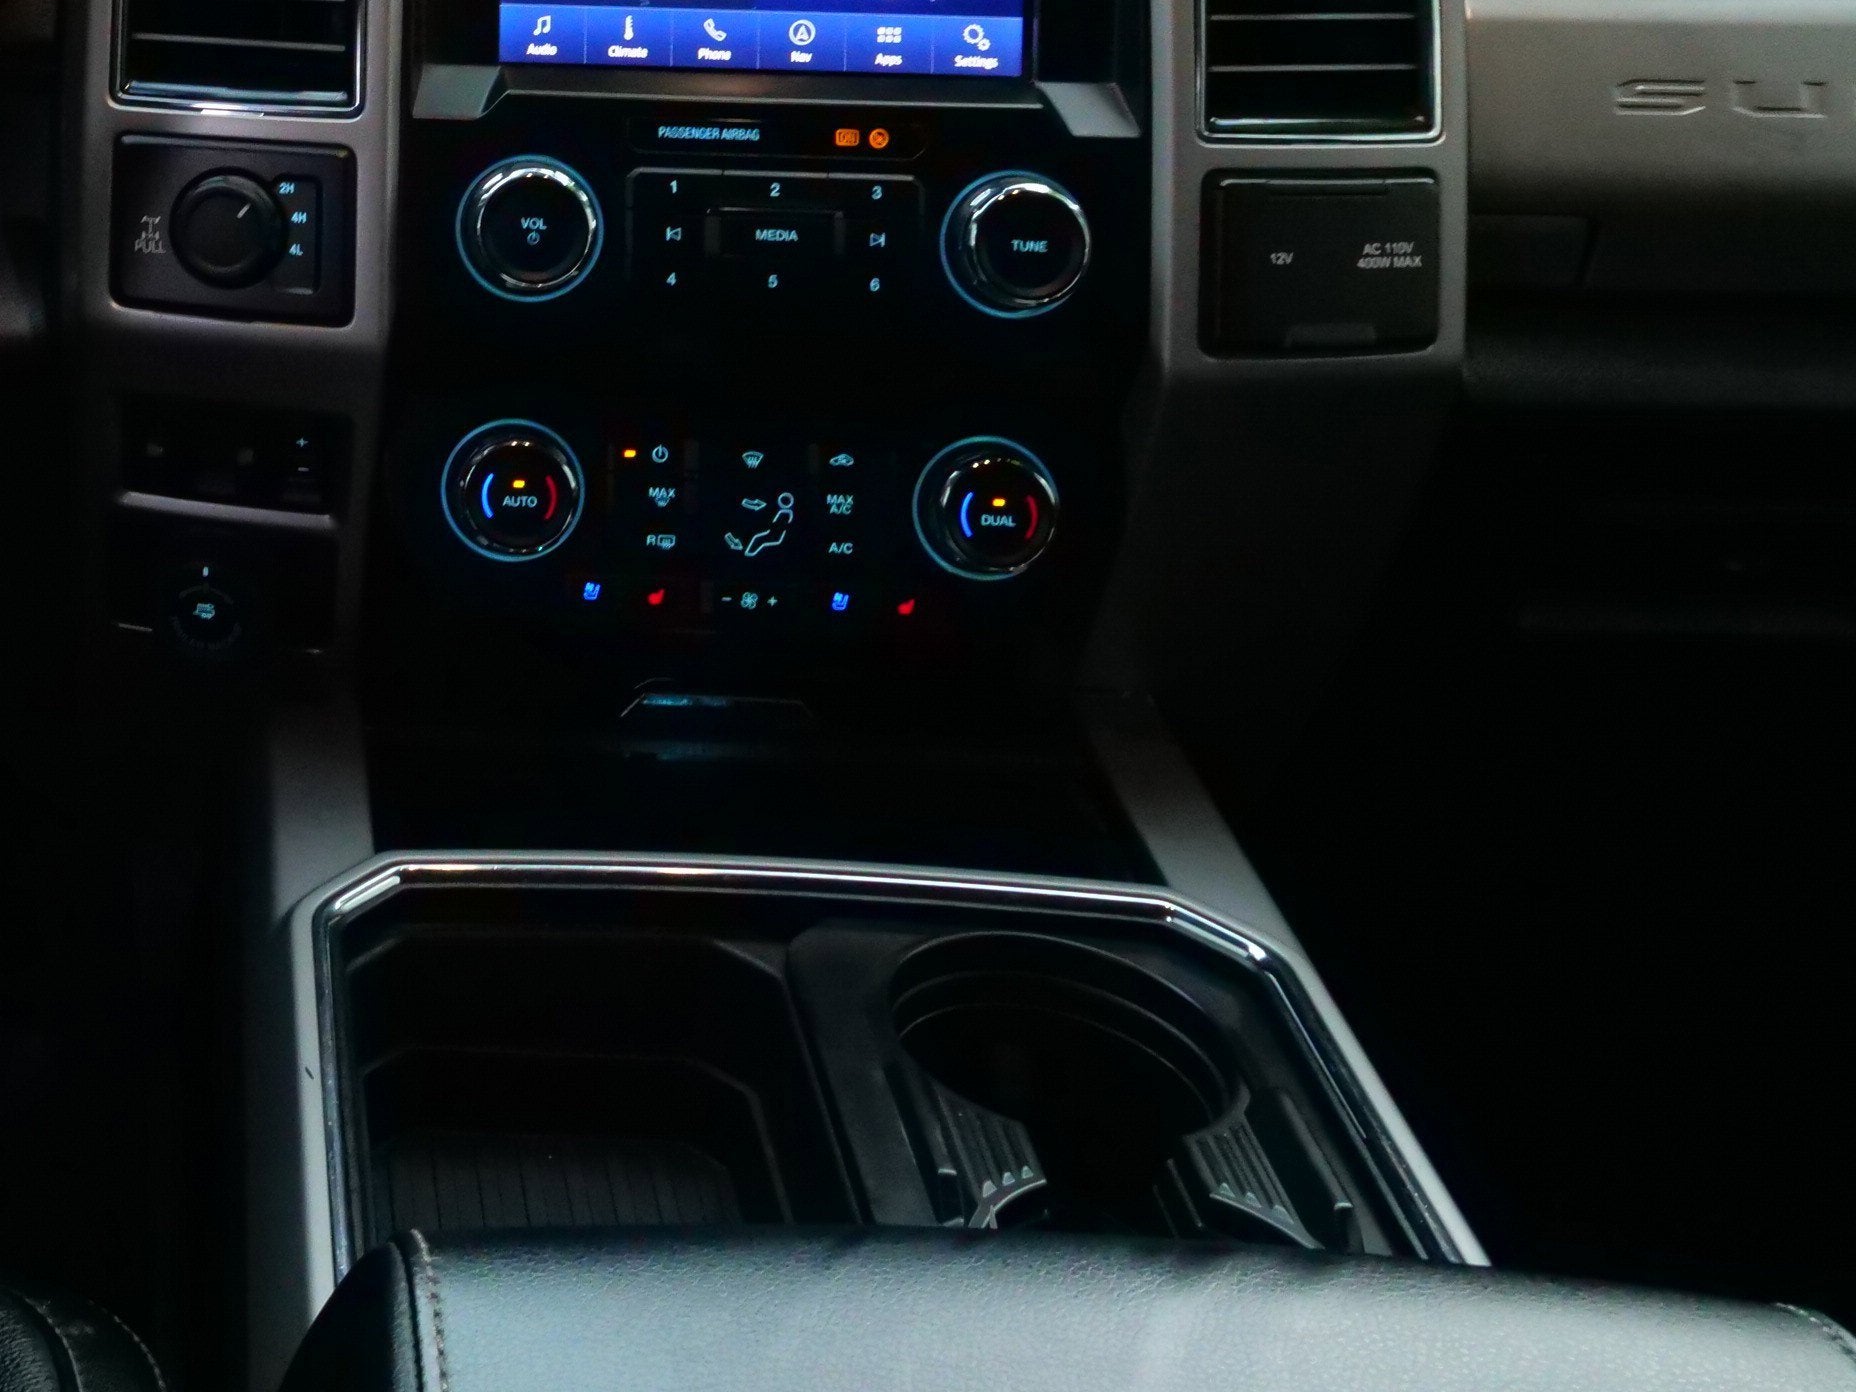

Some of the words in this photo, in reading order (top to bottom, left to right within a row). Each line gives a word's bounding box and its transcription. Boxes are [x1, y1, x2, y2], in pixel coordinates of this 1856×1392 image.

[526, 43, 558, 56] Audio
[608, 45, 649, 59] Climate
[697, 48, 732, 61] Phone
[790, 50, 813, 63] Nav
[875, 52, 903, 67] Apps
[954, 54, 999, 69] Settings
[658, 125, 721, 140] PASSENGER
[721, 127, 761, 142] AIRBAG
[278, 181, 297, 195] 2H
[669, 180, 679, 195] 1
[769, 181, 781, 198] 2
[870, 184, 883, 200] 3
[290, 210, 309, 224] 4H
[520, 216, 547, 230] VOL
[755, 228, 799, 243] MEDIA
[288, 242, 304, 257] 4L
[1010, 238, 1049, 253] TUNE
[1363, 242, 1382, 255] AC
[1270, 251, 1294, 265] 12V
[1393, 254, 1423, 268] MAX
[666, 271, 678, 287] 4
[767, 273, 779, 289] 5
[869, 276, 881, 292] 6
[648, 486, 676, 499] MAX
[826, 493, 854, 506] MAX
[503, 494, 538, 508] AUTO
[829, 504, 852, 515] A/C
[980, 513, 1017, 528] DUAL
[646, 534, 657, 547] R
[828, 541, 854, 555] A/C
